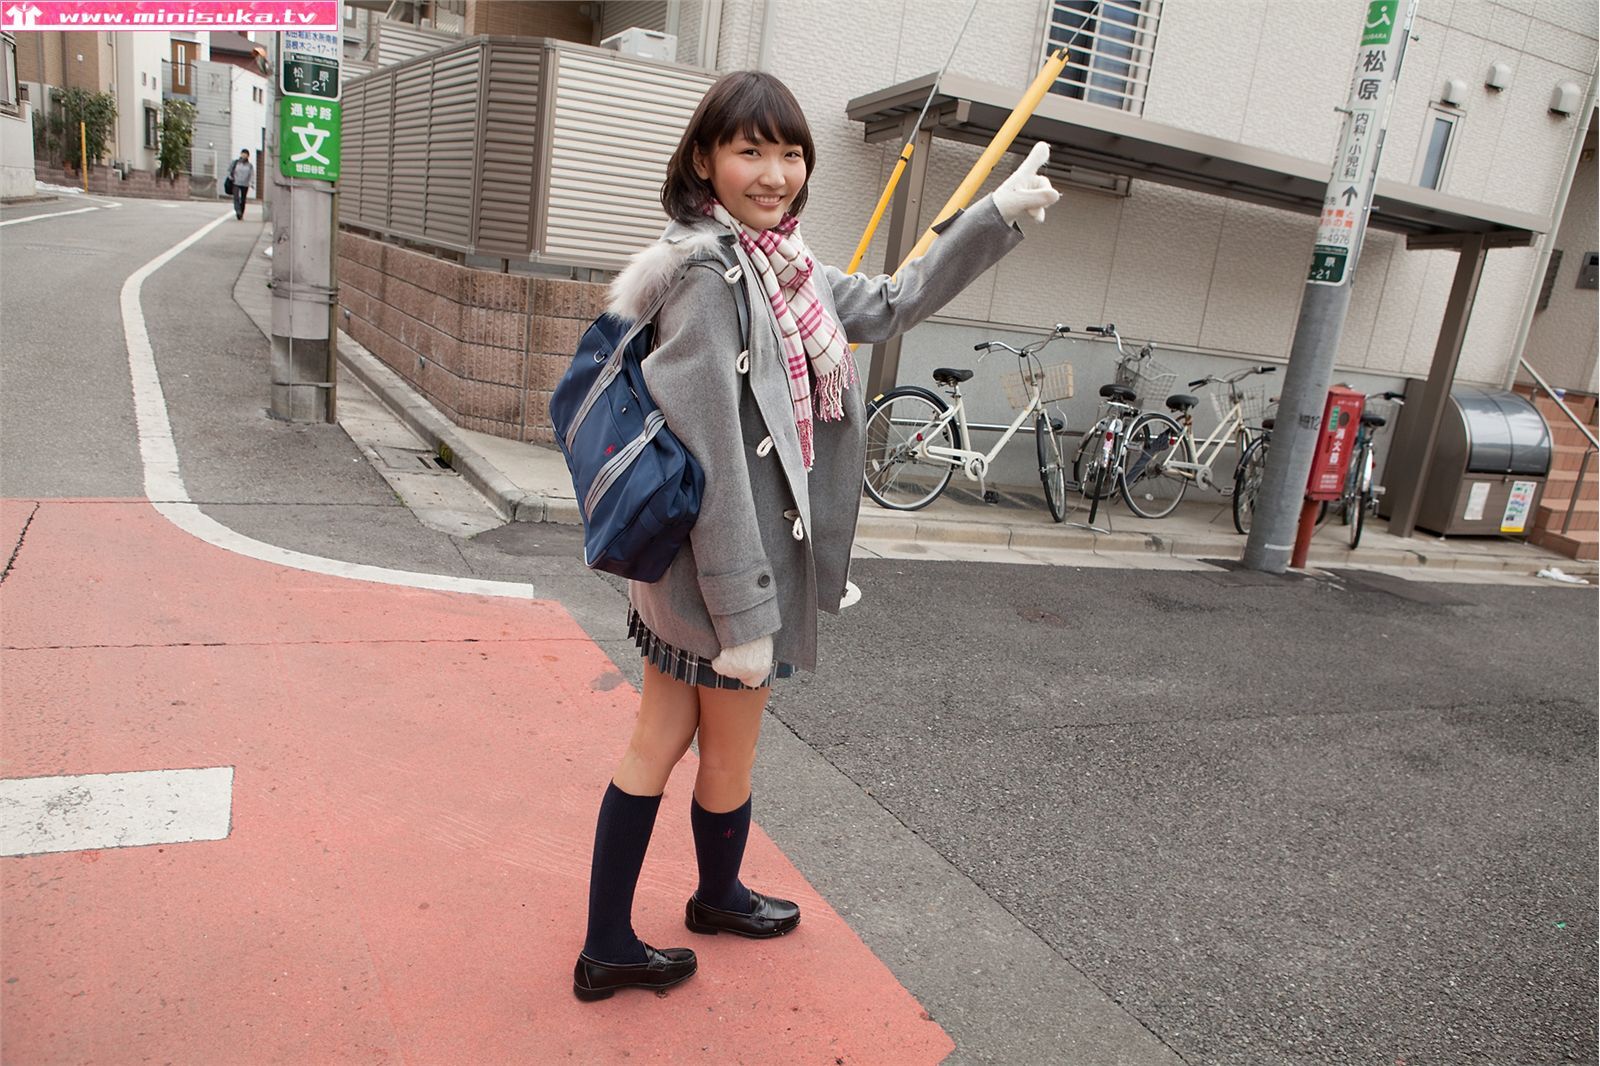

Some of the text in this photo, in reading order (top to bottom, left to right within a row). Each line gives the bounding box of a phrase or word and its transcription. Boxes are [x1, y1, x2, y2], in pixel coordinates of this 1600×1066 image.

[294, 78, 326, 92] 1-21
[1358, 49, 1387, 101] 松原
[290, 102, 332, 121] 通学路
[291, 121, 331, 165] 文
[1345, 113, 1369, 178] 内科・小児科
[295, 163, 325, 175] 世田谷区
